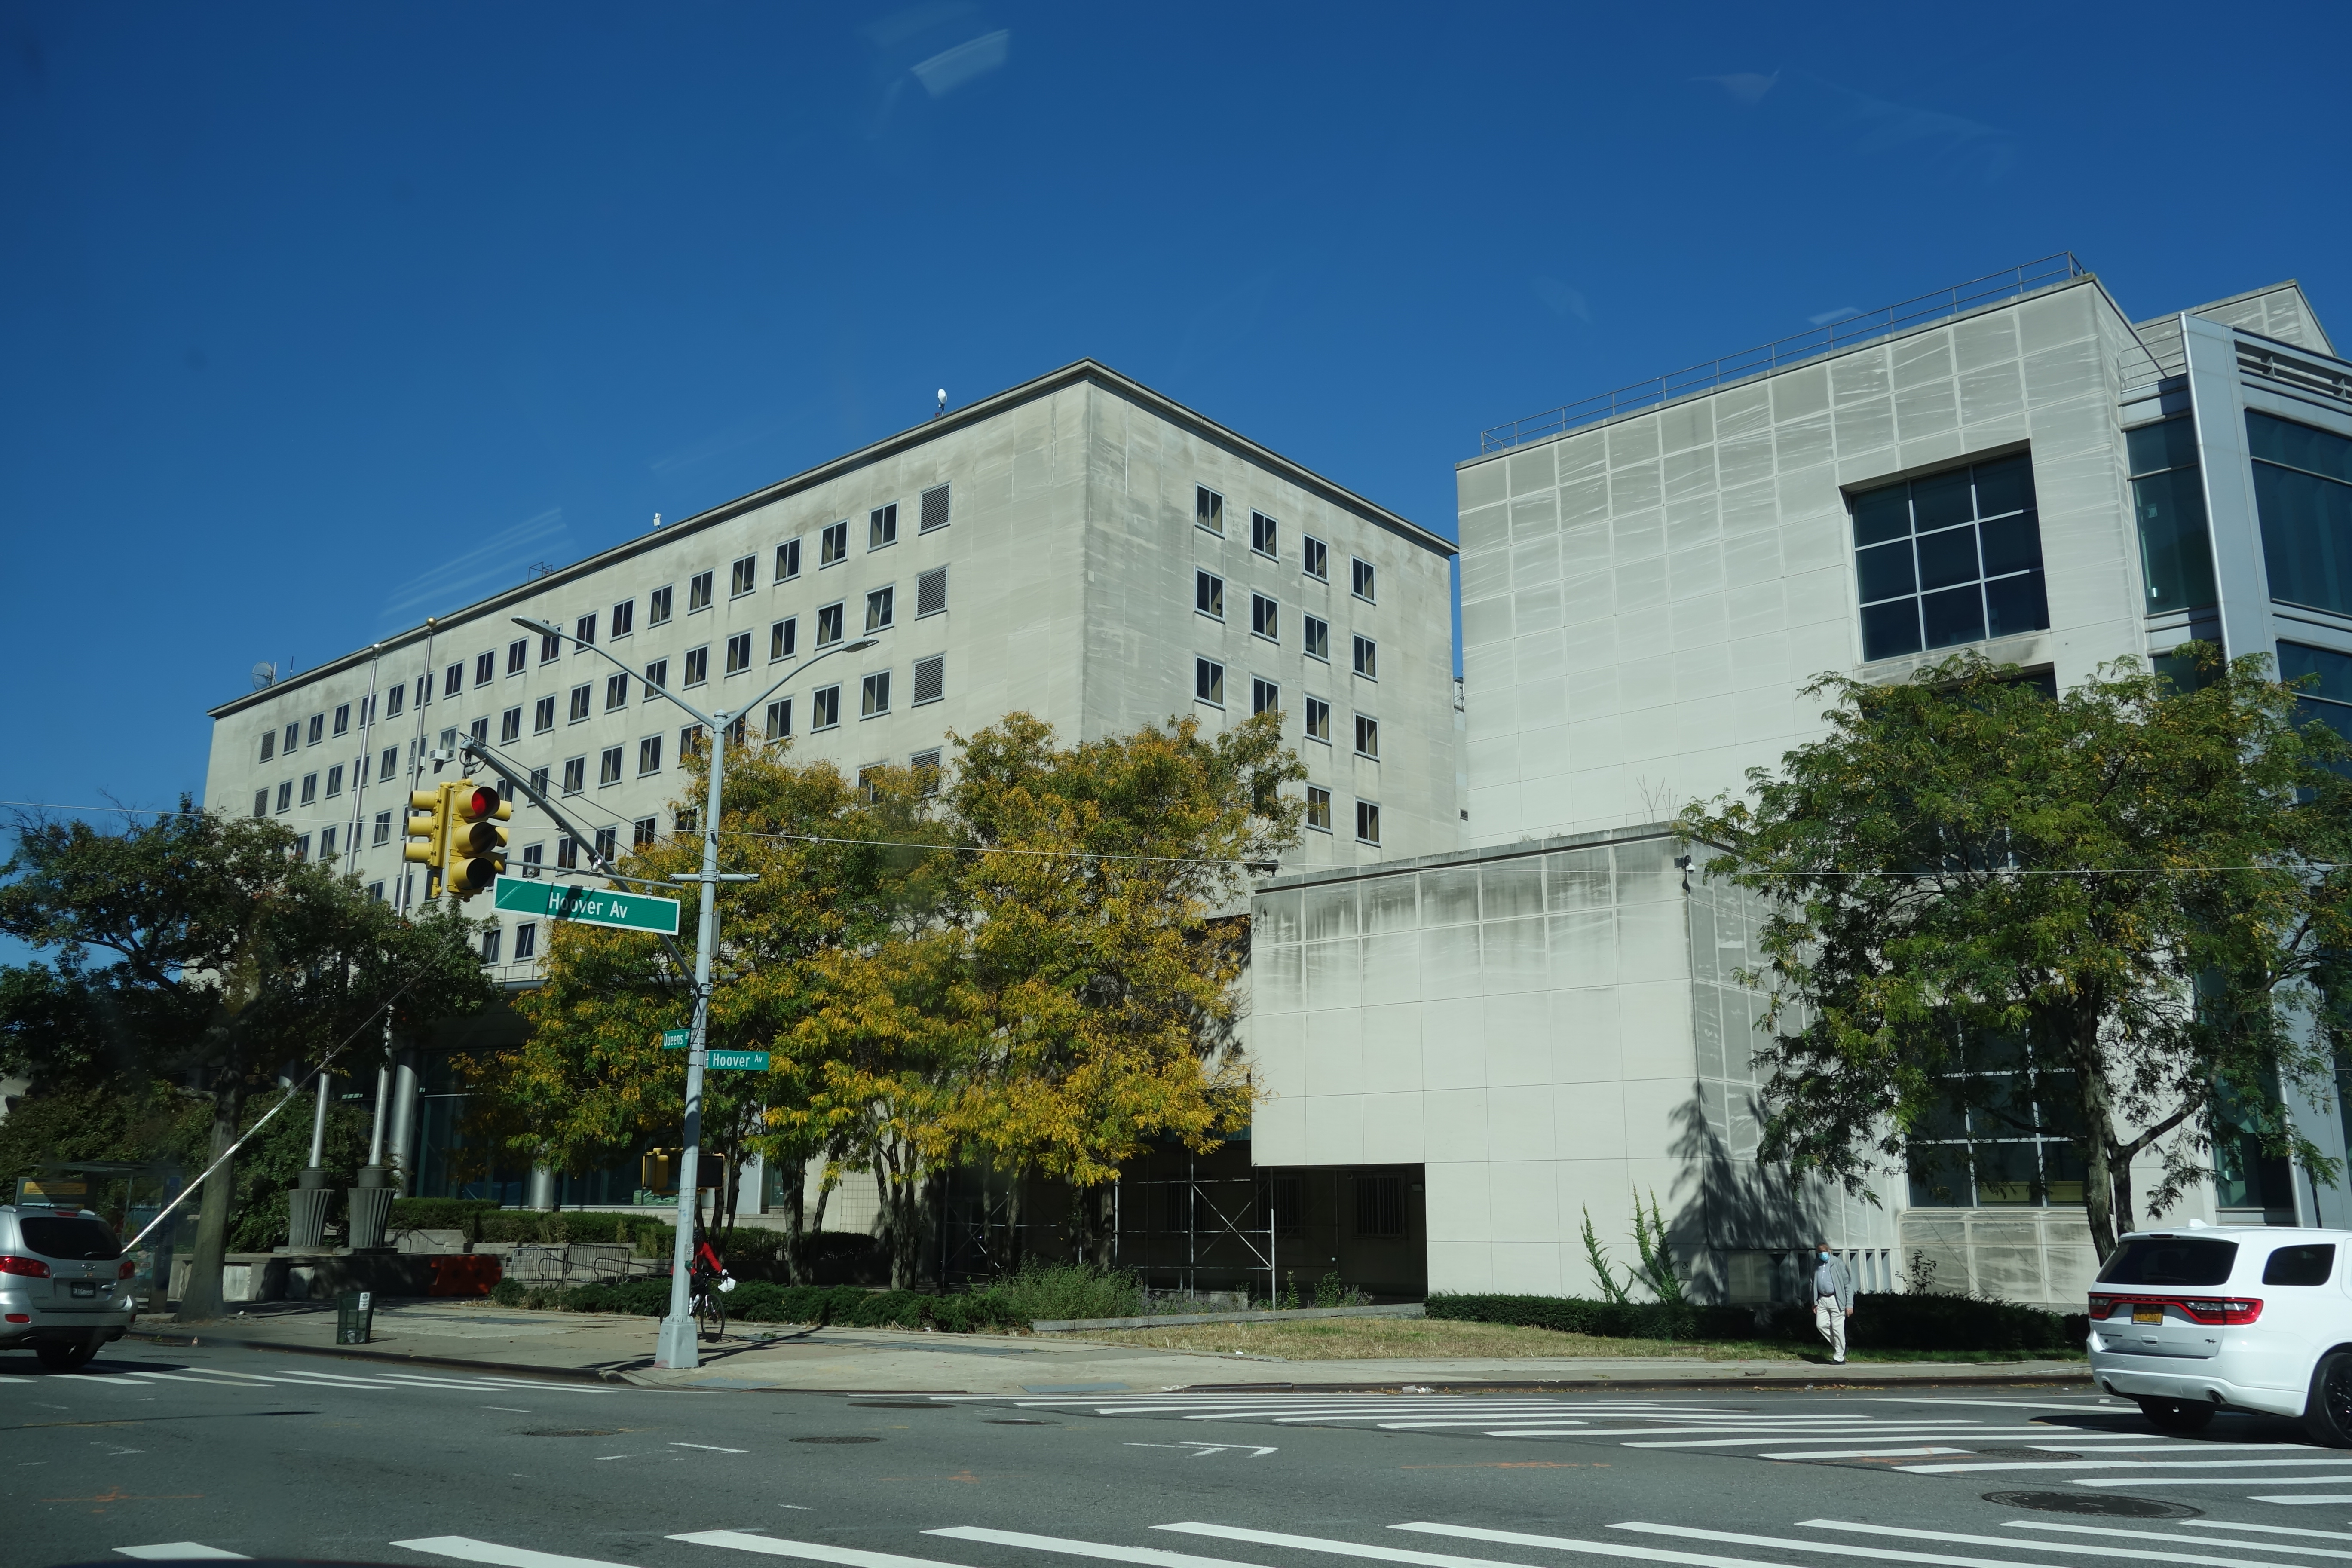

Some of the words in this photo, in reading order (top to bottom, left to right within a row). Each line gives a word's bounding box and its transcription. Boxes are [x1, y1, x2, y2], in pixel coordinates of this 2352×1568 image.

[548, 891, 603, 916] Hoover
[609, 900, 628, 919] Av
[663, 1033, 683, 1047] Queens
[712, 1053, 750, 1067] Hoover
[754, 1054, 763, 1063] Av
